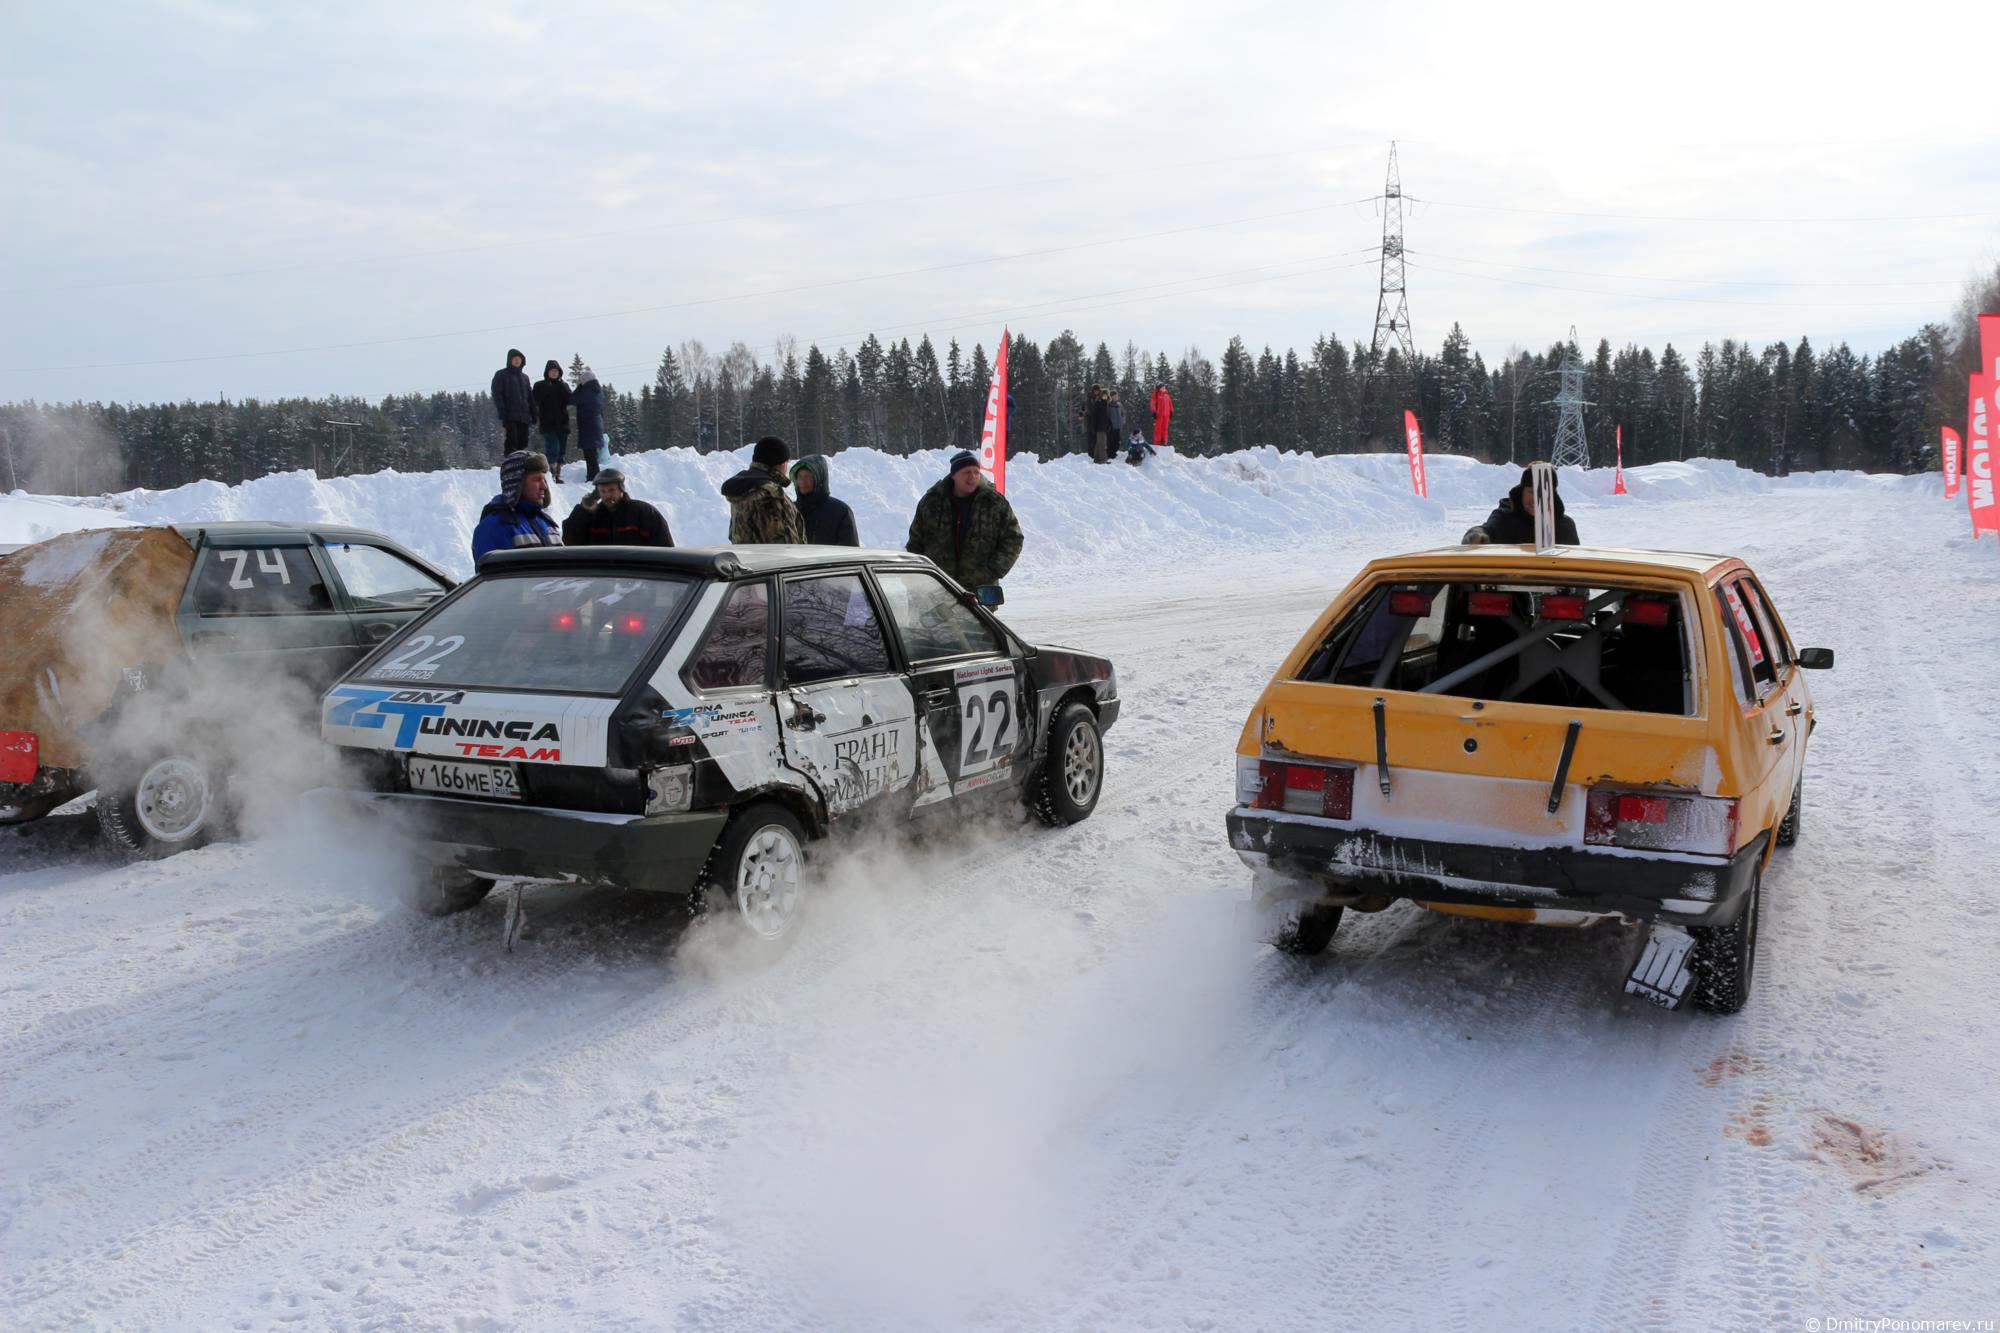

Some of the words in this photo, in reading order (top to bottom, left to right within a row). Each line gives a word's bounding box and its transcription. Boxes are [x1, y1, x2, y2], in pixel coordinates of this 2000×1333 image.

[381, 635, 465, 670] 22
[956, 669, 980, 680] National
[326, 687, 466, 730] ZONA
[728, 717, 756, 725] TEAM
[963, 690, 1013, 766] 22
[456, 742, 560, 762] TEAM
[834, 729, 899, 770] ГРАНД
[493, 768, 514, 788] 52
